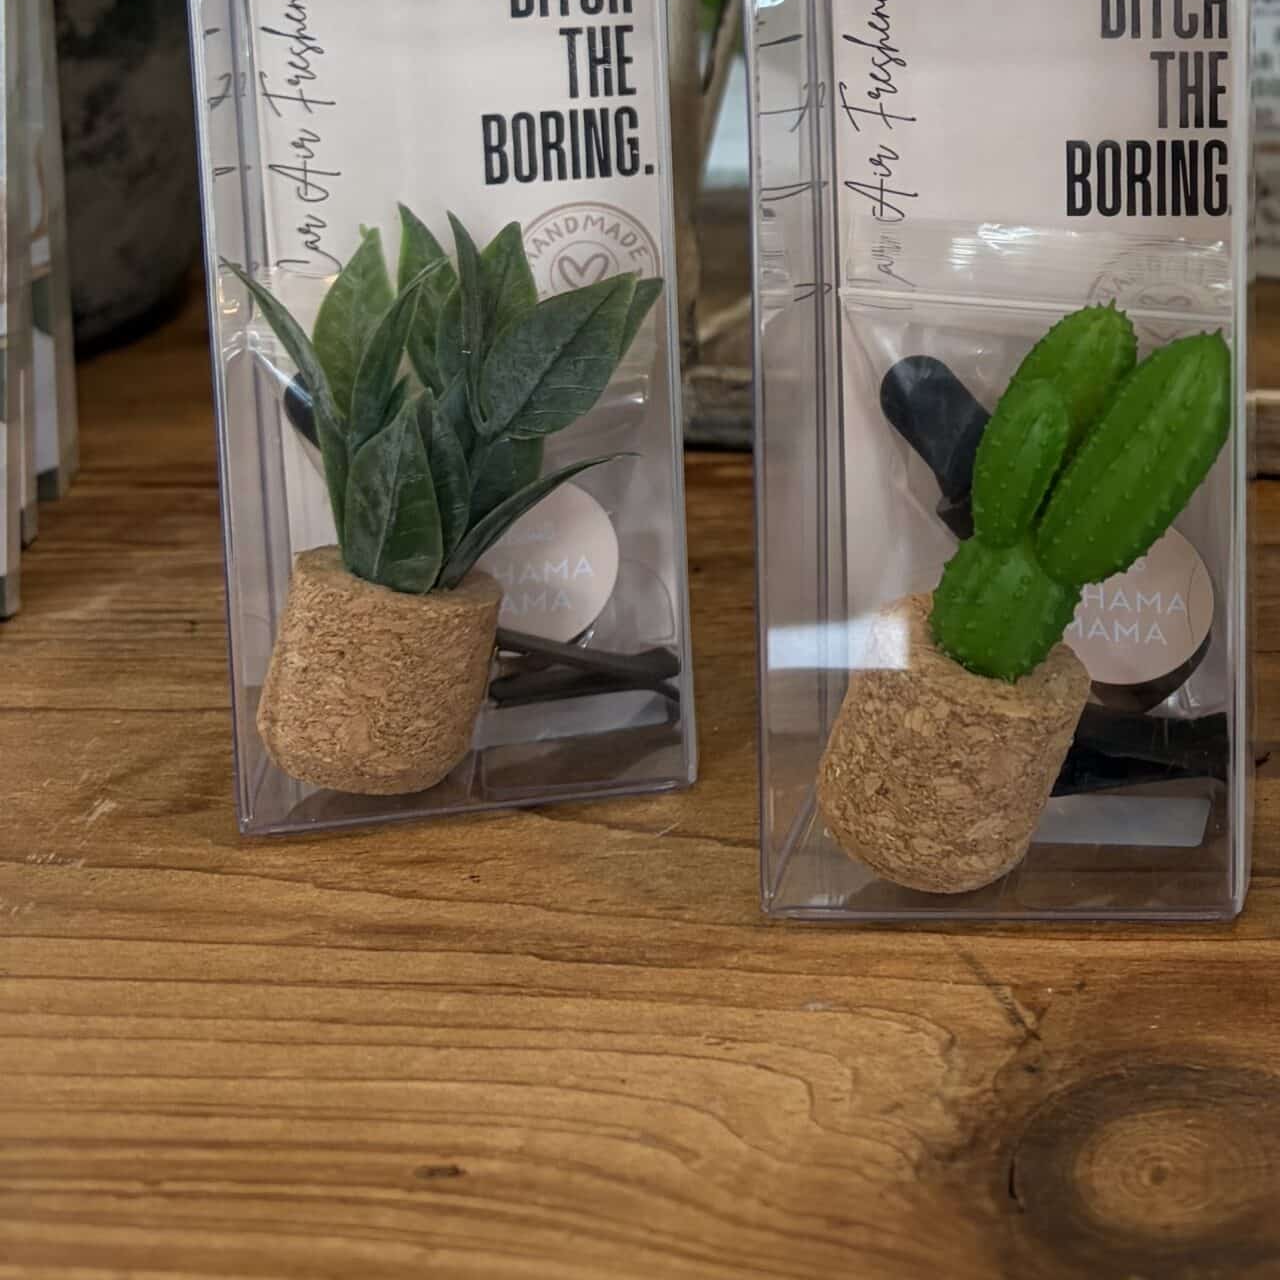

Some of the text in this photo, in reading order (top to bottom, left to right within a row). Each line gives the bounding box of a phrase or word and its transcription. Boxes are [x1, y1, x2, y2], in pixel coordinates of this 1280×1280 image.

[559, 25, 638, 99] THE
[1149, 50, 1230, 129] THE
[267, 128, 342, 202] Air
[481, 106, 657, 186] BORING.
[843, 144, 919, 222] Air
[1065, 139, 1231, 217] BORING
